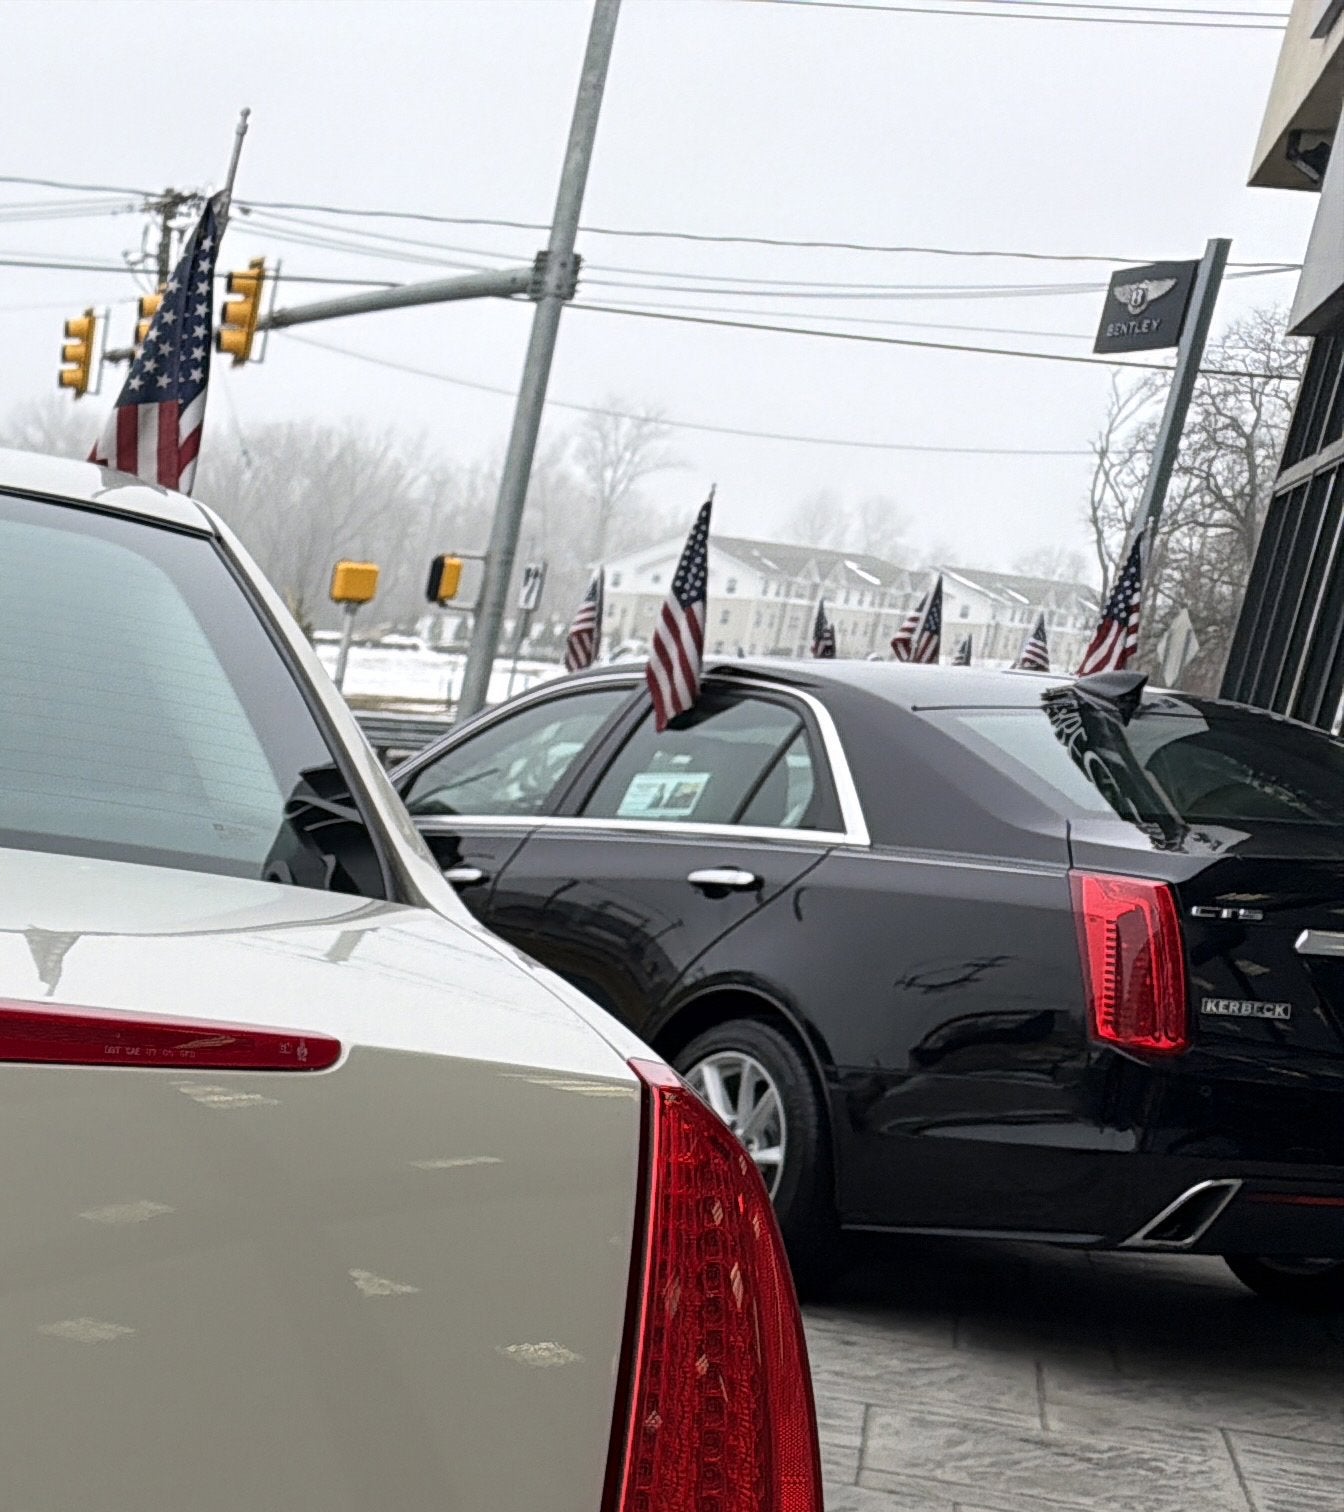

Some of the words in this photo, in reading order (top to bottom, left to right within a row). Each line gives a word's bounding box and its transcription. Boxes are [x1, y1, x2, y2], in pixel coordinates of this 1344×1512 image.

[1106, 318, 1161, 337] BENTLEY
[1191, 905, 1263, 920] CTS
[1205, 999, 1285, 1018] KERBECK
